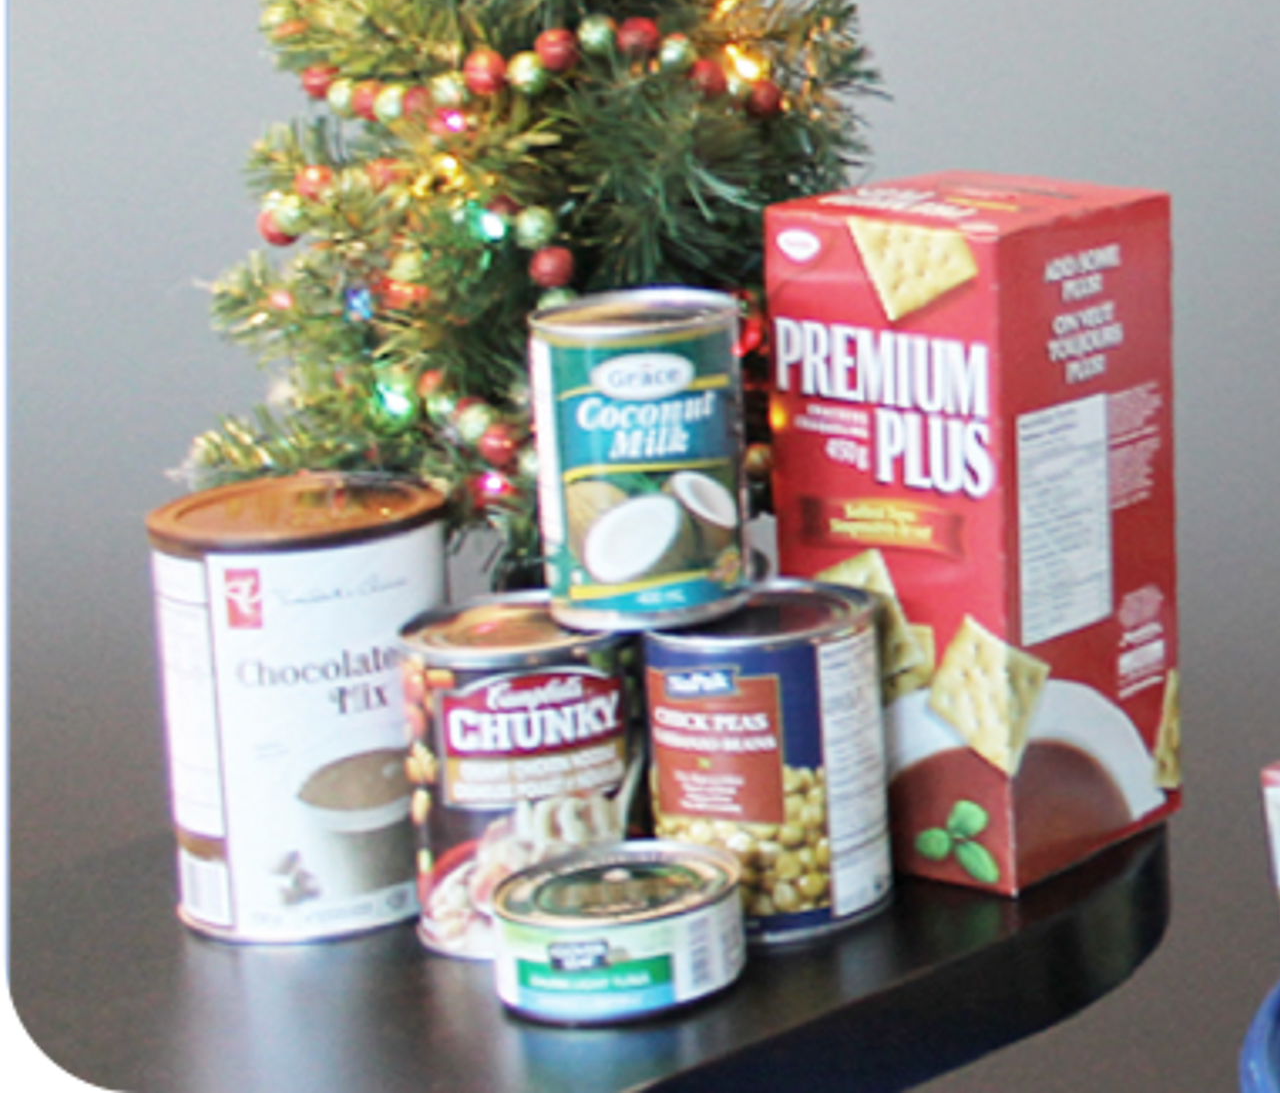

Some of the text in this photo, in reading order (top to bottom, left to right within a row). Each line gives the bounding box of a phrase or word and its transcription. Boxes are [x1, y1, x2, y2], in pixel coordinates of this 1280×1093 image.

[608, 367, 681, 390] Grace
[774, 316, 989, 418] PREMIUM
[575, 390, 717, 432] Coconut
[609, 427, 691, 460] Milk
[875, 407, 997, 497] PLUS
[448, 690, 622, 753] CHUNKY
[712, 711, 770, 732] PEAS
